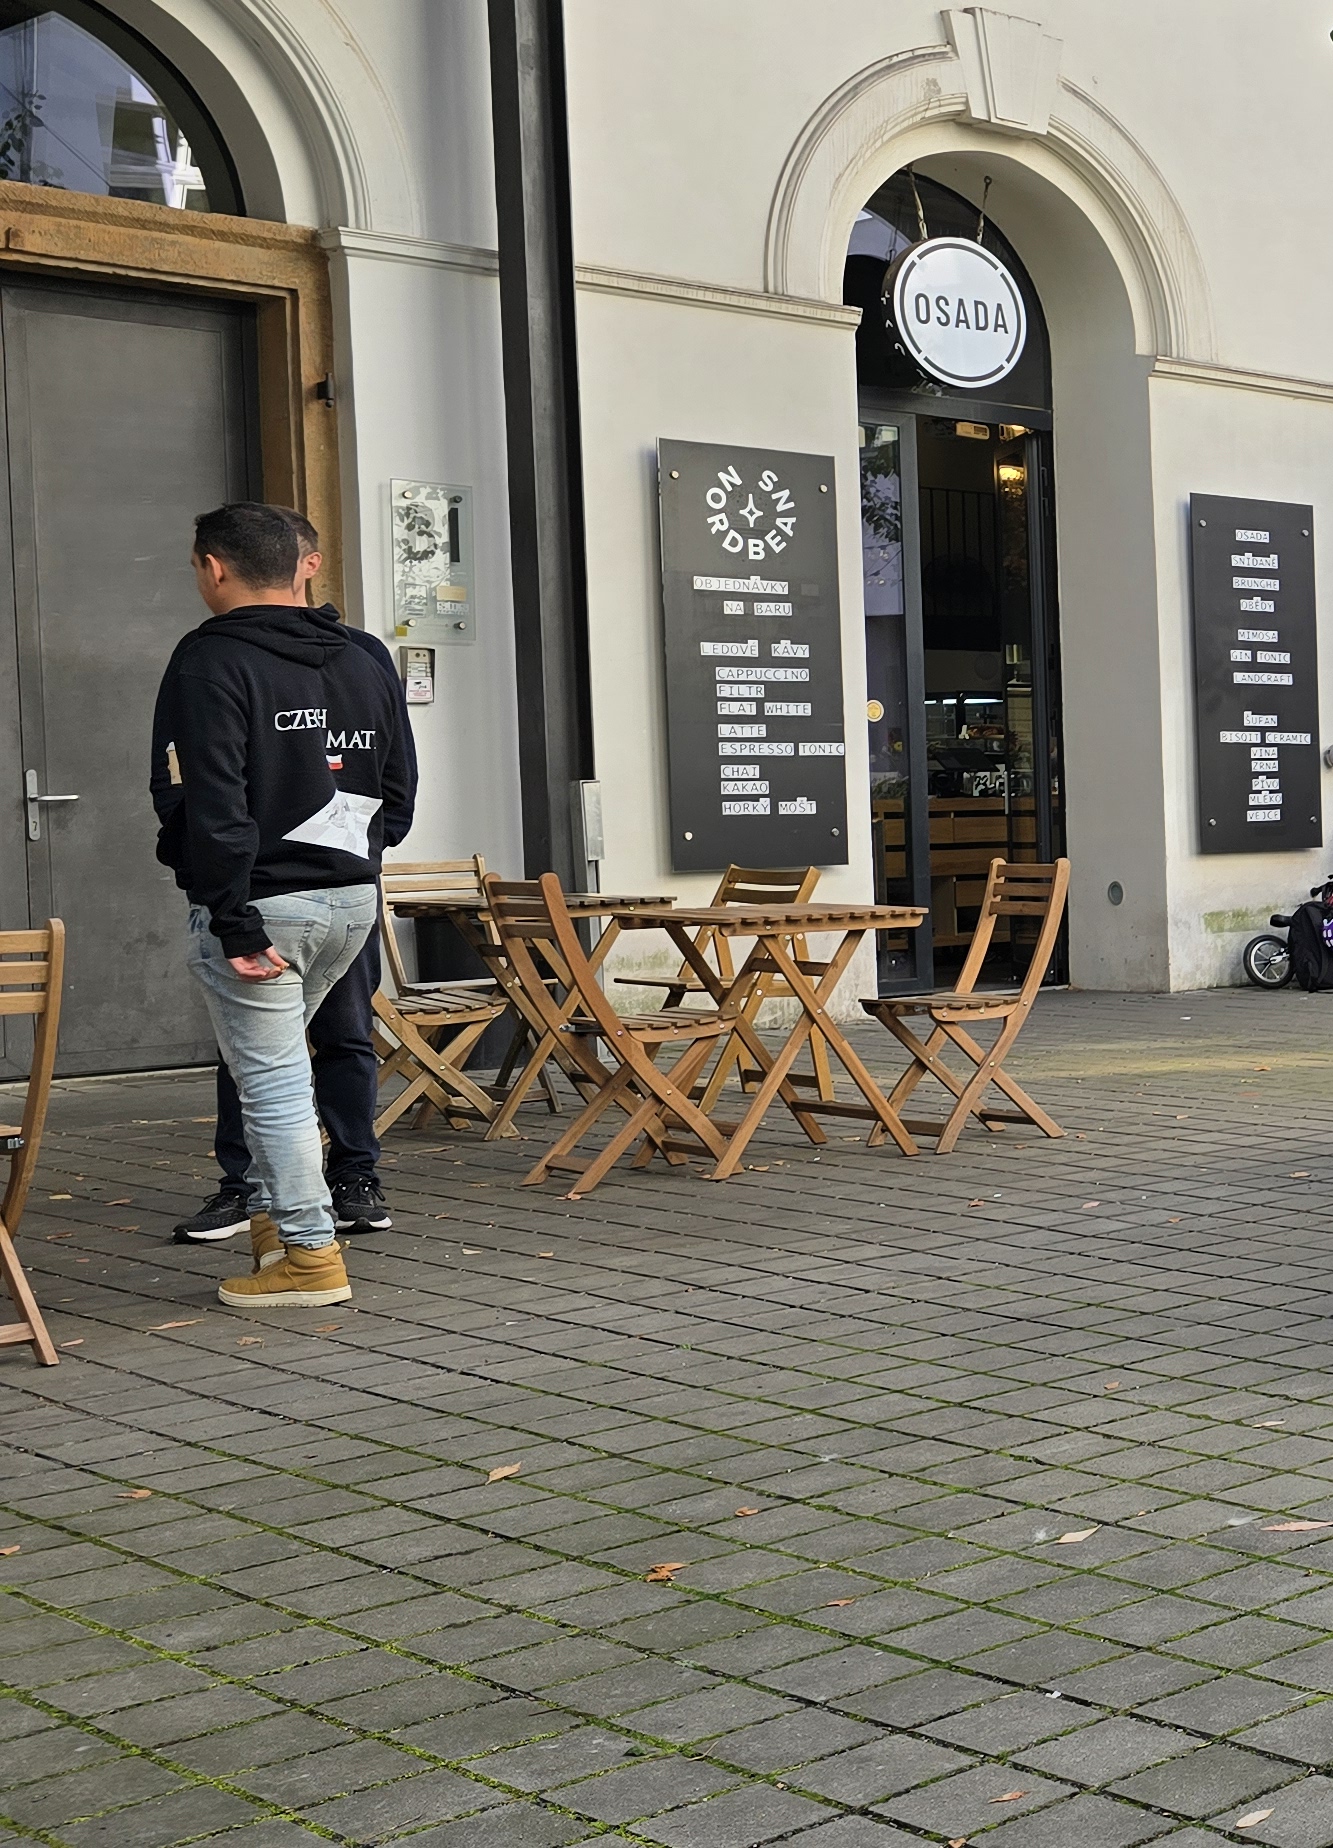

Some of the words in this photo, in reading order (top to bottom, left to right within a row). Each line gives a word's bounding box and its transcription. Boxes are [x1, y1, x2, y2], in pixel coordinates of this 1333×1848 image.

[914, 293, 1008, 334] OSADA
[1236, 531, 1269, 541] OSADA
[694, 577, 788, 594] OBJEDNÁVKY
[1234, 578, 1278, 589] BRUNCHE
[725, 602, 744, 614] NA
[755, 604, 791, 615] BARU
[1238, 631, 1277, 641] MIMOSA
[701, 641, 757, 656] LEDOVÉ
[772, 642, 809, 657] KÁVY
[1231, 651, 1250, 660] GIN
[1258, 653, 1289, 662] TONIC
[717, 668, 808, 680] CAPPUCCINO
[1235, 674, 1291, 684] LANDCRAFT
[718, 685, 763, 696] FILTR
[719, 703, 755, 713] FLAT
[765, 704, 810, 714] WHITE
[719, 725, 765, 736] LATTE
[325, 729, 376, 750] MAT
[1266, 733, 1309, 743] CERAMIC
[720, 744, 793, 754] ESPRESSO
[801, 744, 844, 754] TONIC
[1252, 761, 1277, 770] ZRNA
[722, 766, 758, 777] CHAI
[722, 782, 768, 793] KAKAO
[723, 800, 769, 813] HORKÝ
[780, 799, 814, 813] MOŠT
[1247, 810, 1279, 821] VEJCE
